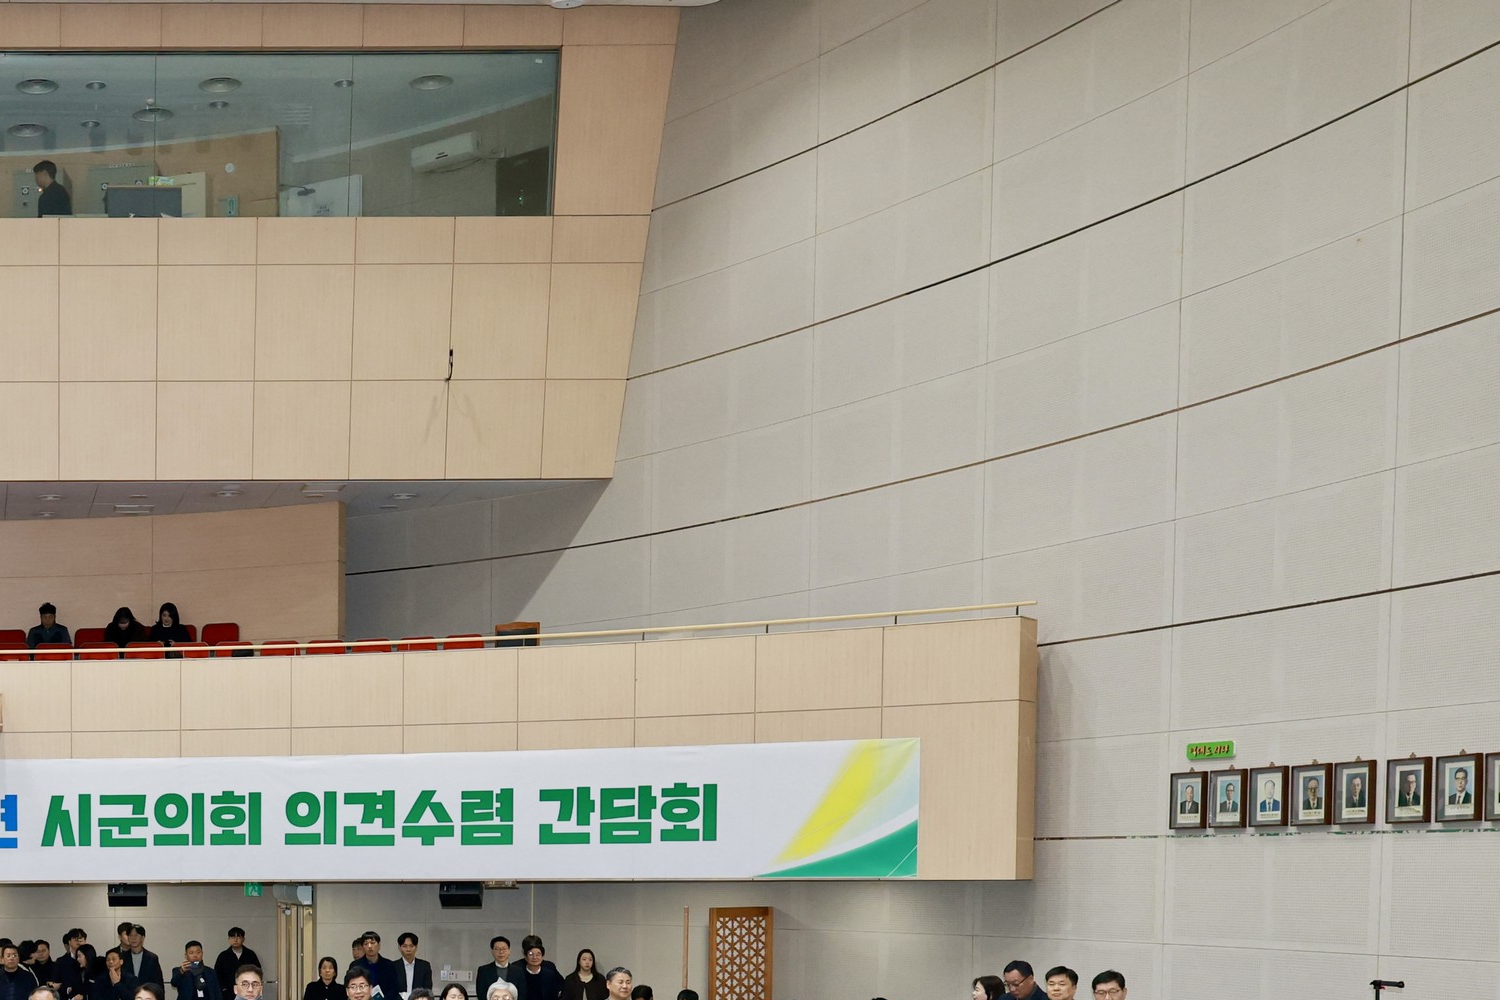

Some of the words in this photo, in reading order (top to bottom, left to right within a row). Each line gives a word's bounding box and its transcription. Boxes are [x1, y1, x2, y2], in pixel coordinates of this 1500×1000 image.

[41, 790, 262, 847] 시군의회
[284, 788, 514, 846] 의견수렴
[539, 783, 718, 844] 간담회
